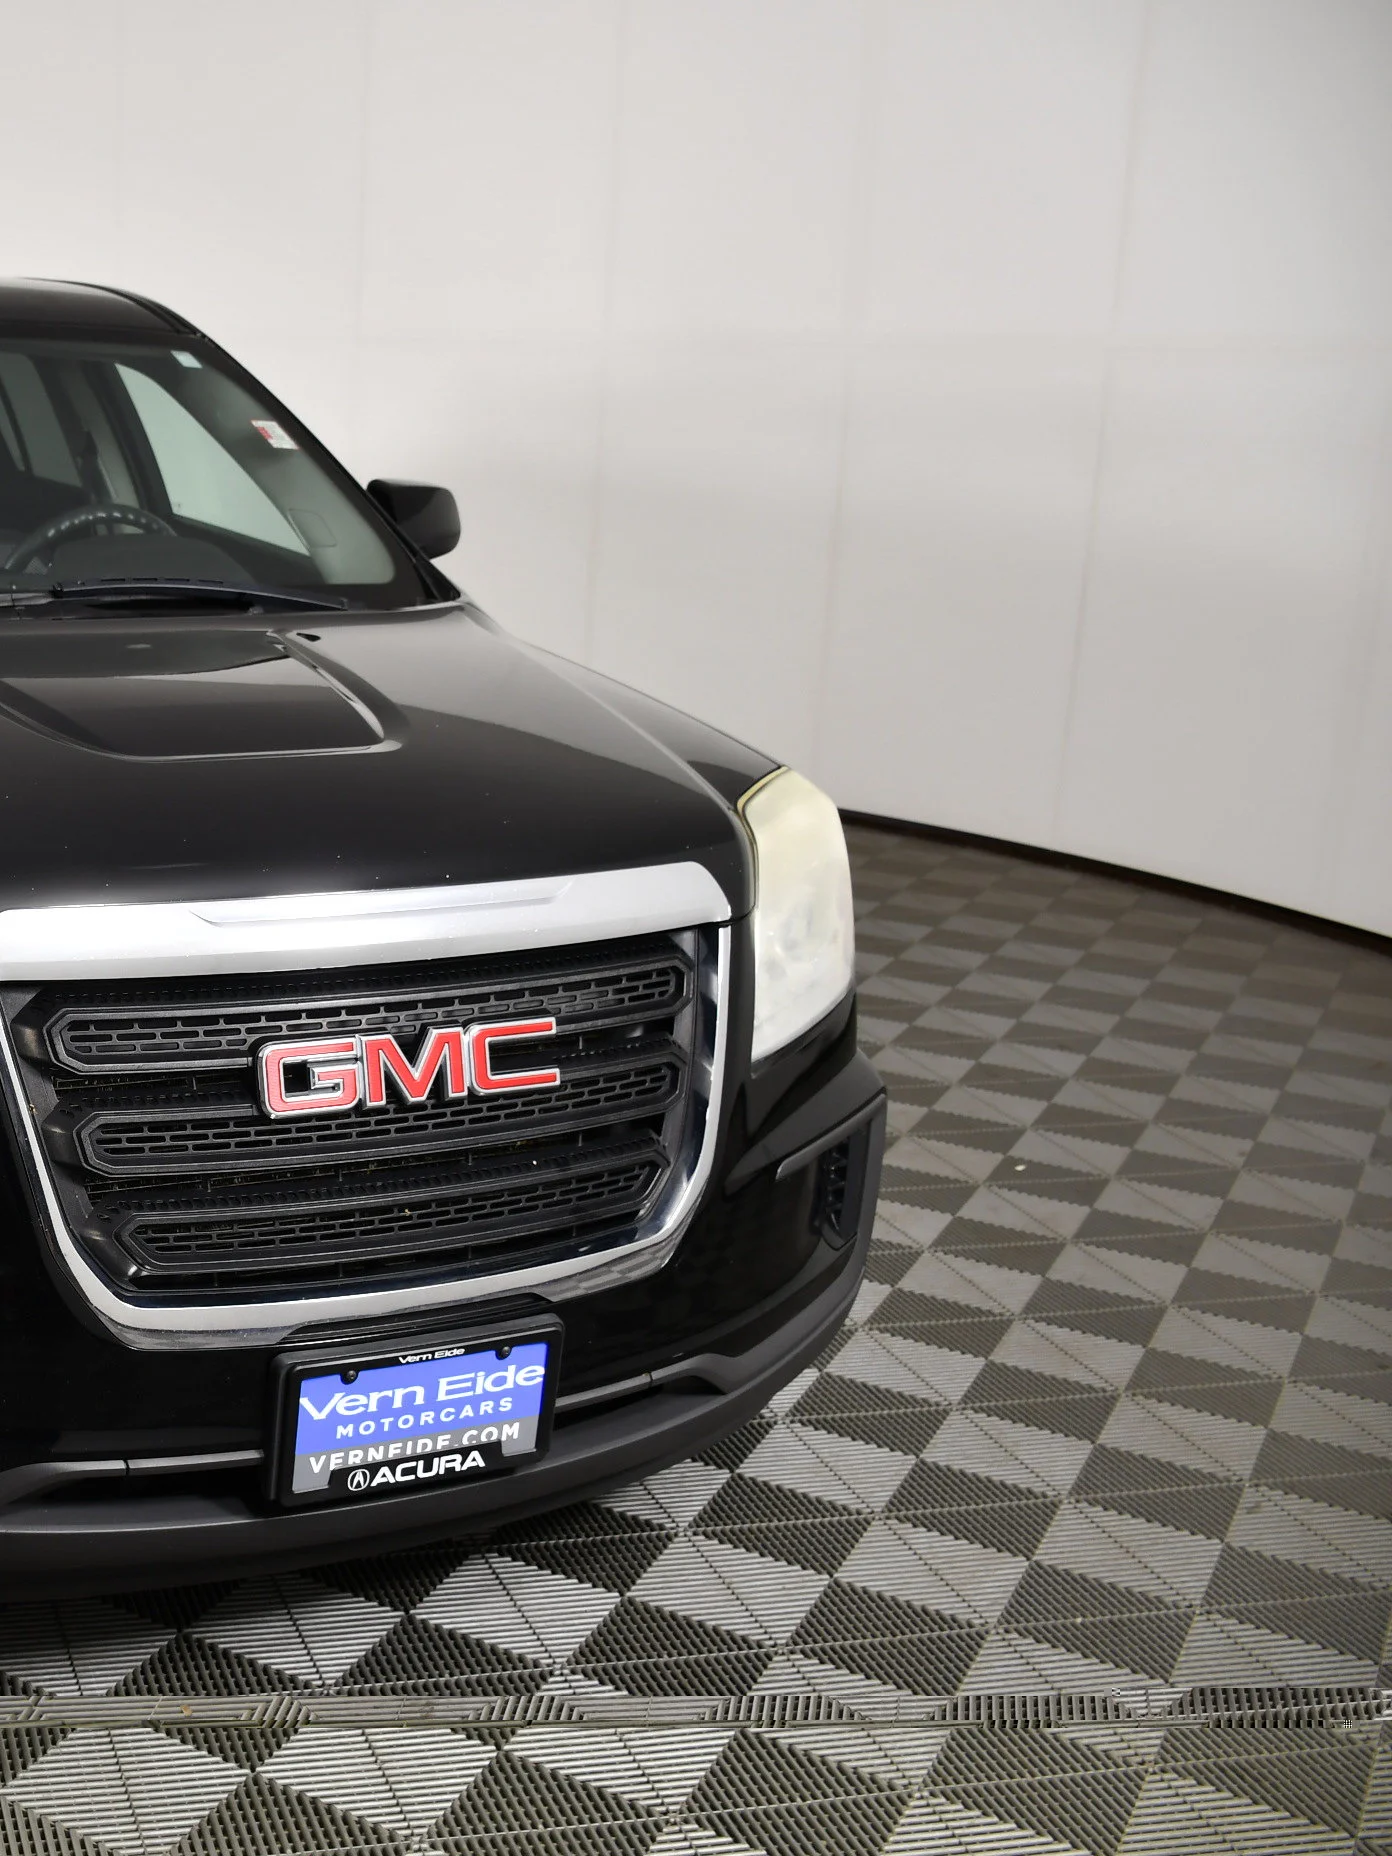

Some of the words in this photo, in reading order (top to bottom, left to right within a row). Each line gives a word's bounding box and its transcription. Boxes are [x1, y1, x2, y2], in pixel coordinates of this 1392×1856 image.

[258, 1017, 560, 1119] GMC
[398, 1352, 434, 1364] Vern
[434, 1348, 465, 1359] Eide
[299, 1385, 425, 1420] Vern
[436, 1364, 545, 1402] Eide
[335, 1396, 514, 1440] MOTORCARS
[370, 1450, 486, 1487] ACURA
